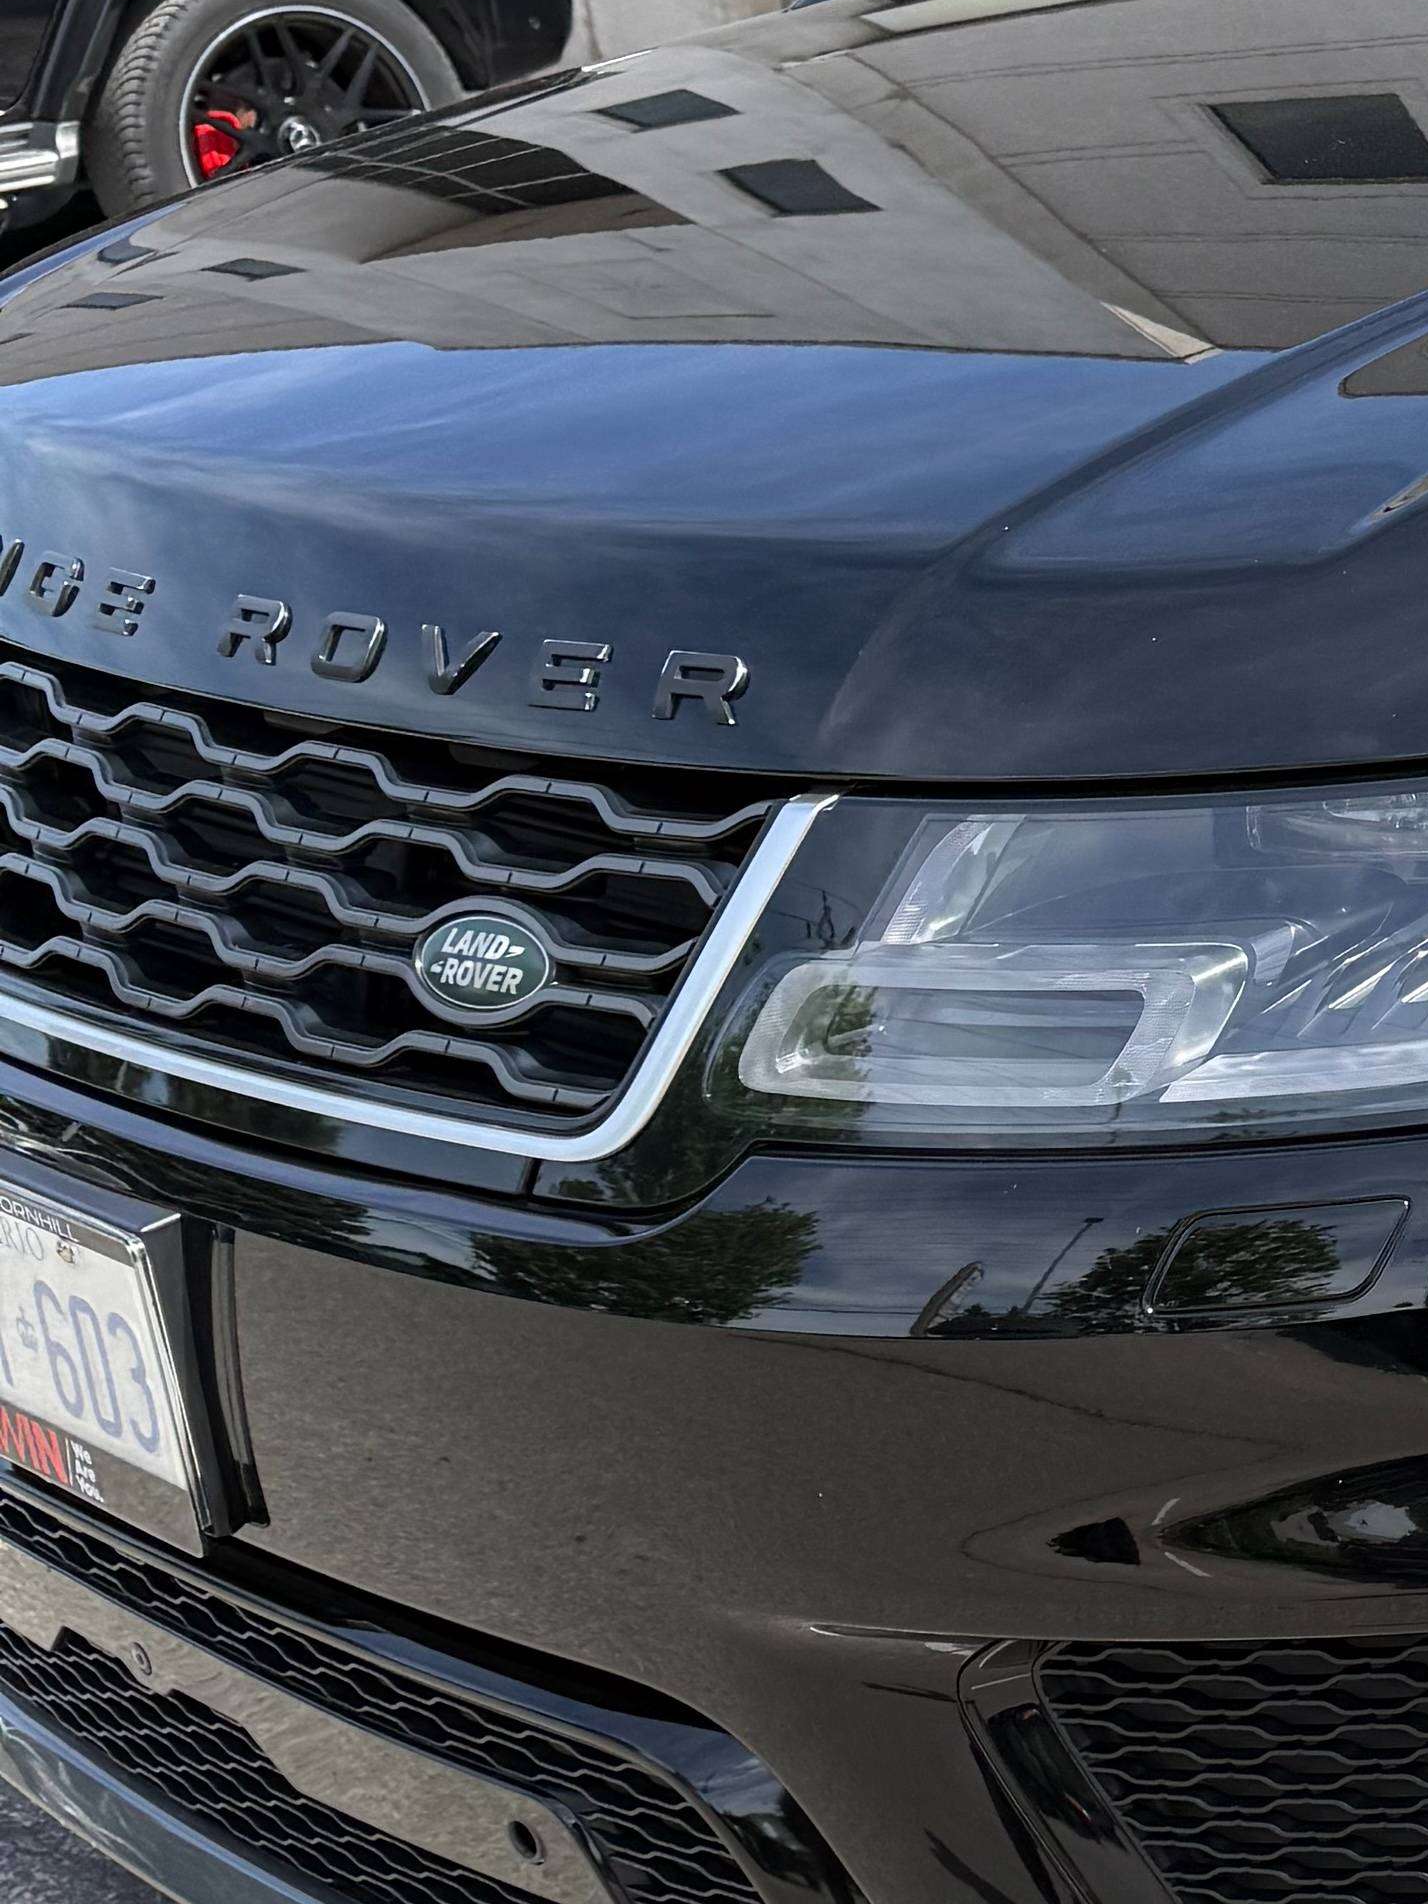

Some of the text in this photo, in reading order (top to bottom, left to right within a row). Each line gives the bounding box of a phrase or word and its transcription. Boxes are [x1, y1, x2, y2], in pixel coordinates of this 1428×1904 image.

[216, 593, 752, 727] ROVER
[441, 927, 511, 960] LAND
[439, 957, 524, 995] ROVER
